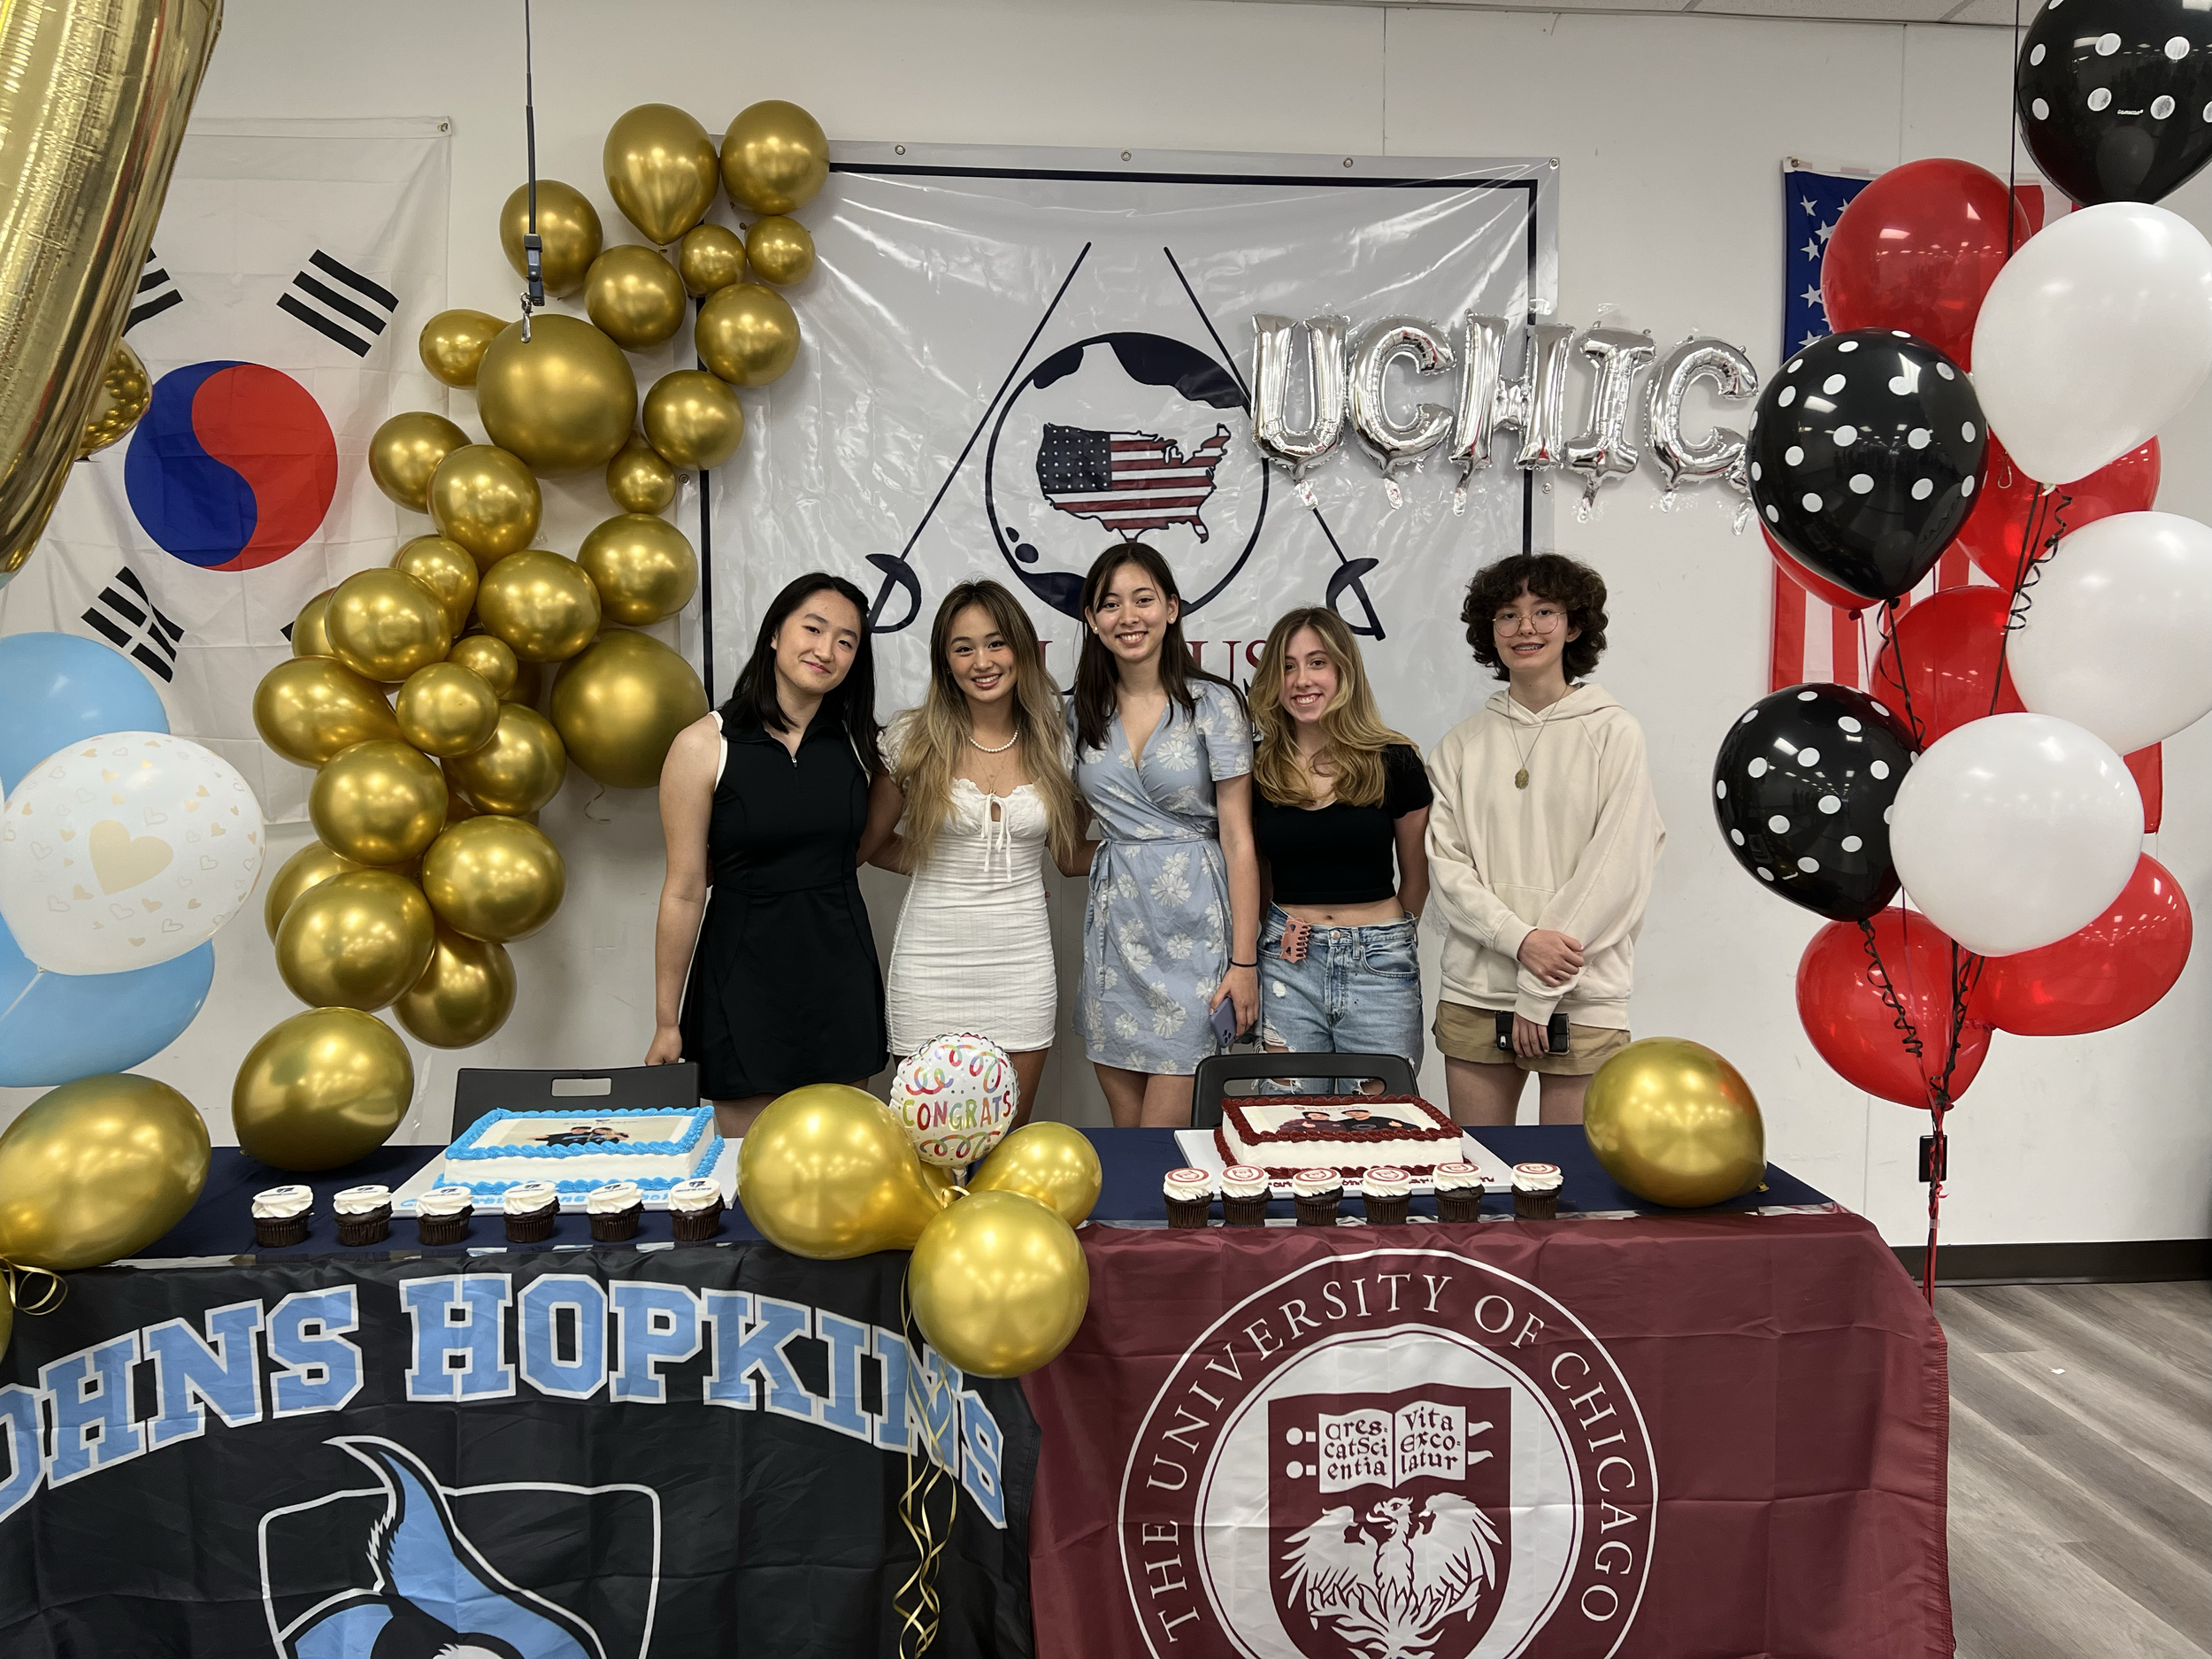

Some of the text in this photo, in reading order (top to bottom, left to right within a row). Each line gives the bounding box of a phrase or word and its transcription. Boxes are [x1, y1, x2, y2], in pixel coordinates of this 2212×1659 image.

[1250, 308, 1761, 489] UCHIC
[0, 1272, 1008, 1530] OHNS HOPKINS
[1142, 1272, 1638, 1644] THE UNIVERSITY OF CHICAGO
[1327, 1456, 1387, 1480] entia
[1401, 1448, 1459, 1475] latur
